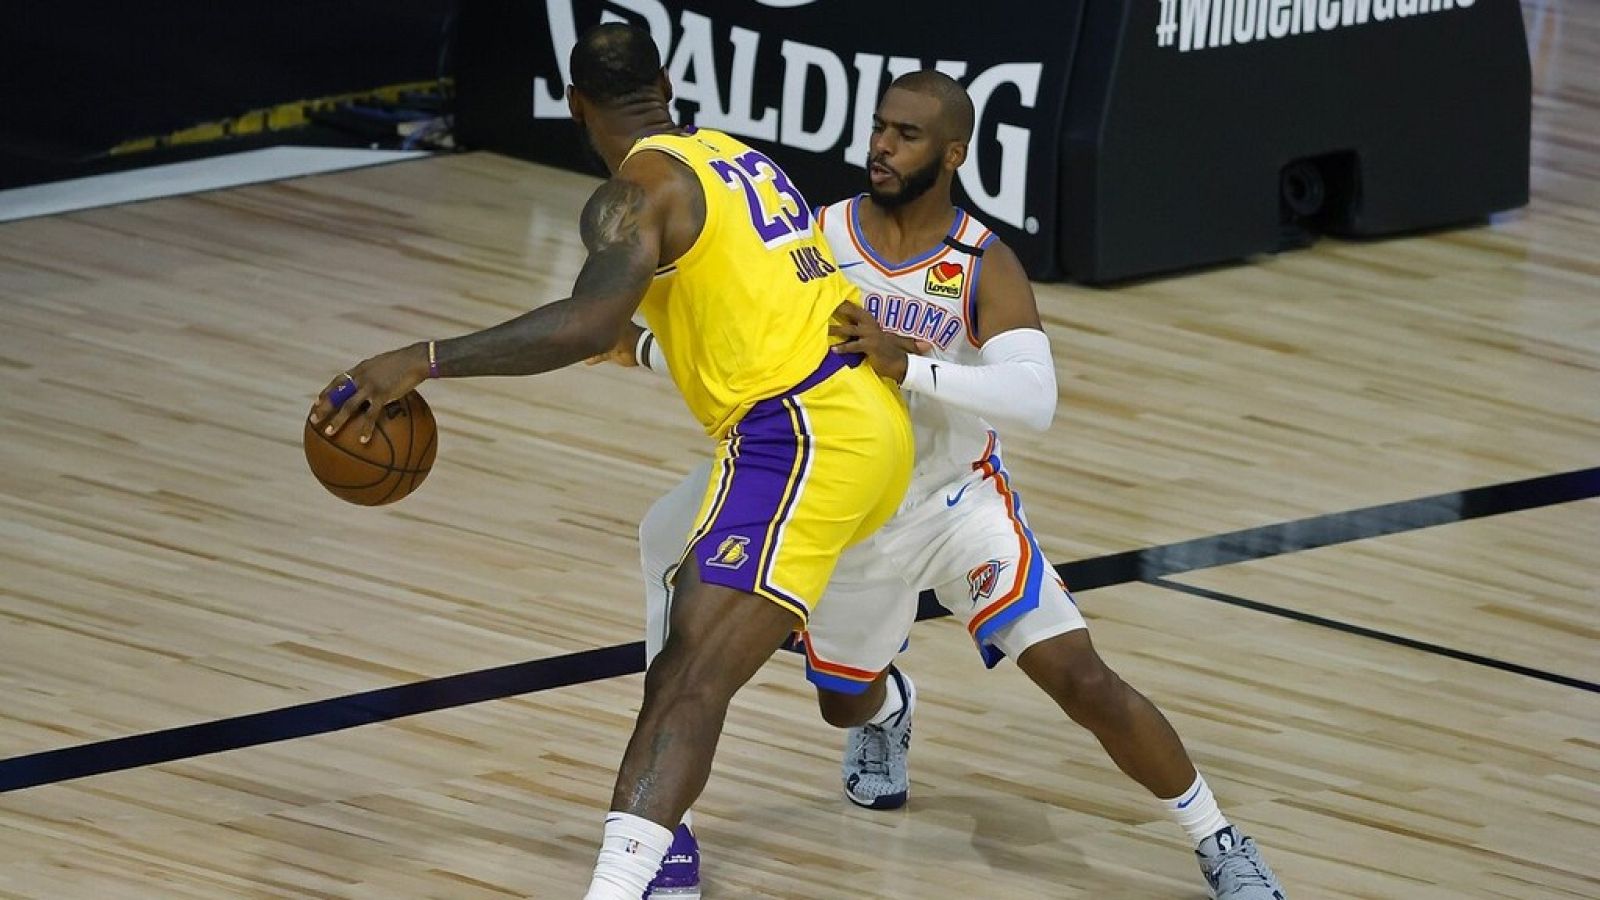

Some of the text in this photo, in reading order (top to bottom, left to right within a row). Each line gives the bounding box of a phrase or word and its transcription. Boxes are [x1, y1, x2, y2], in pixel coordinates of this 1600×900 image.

[1155, 0, 1476, 52] #WholeNew
[533, 0, 1043, 230] ALDIG
[708, 149, 813, 247] 23
[789, 245, 837, 283] JAMES
